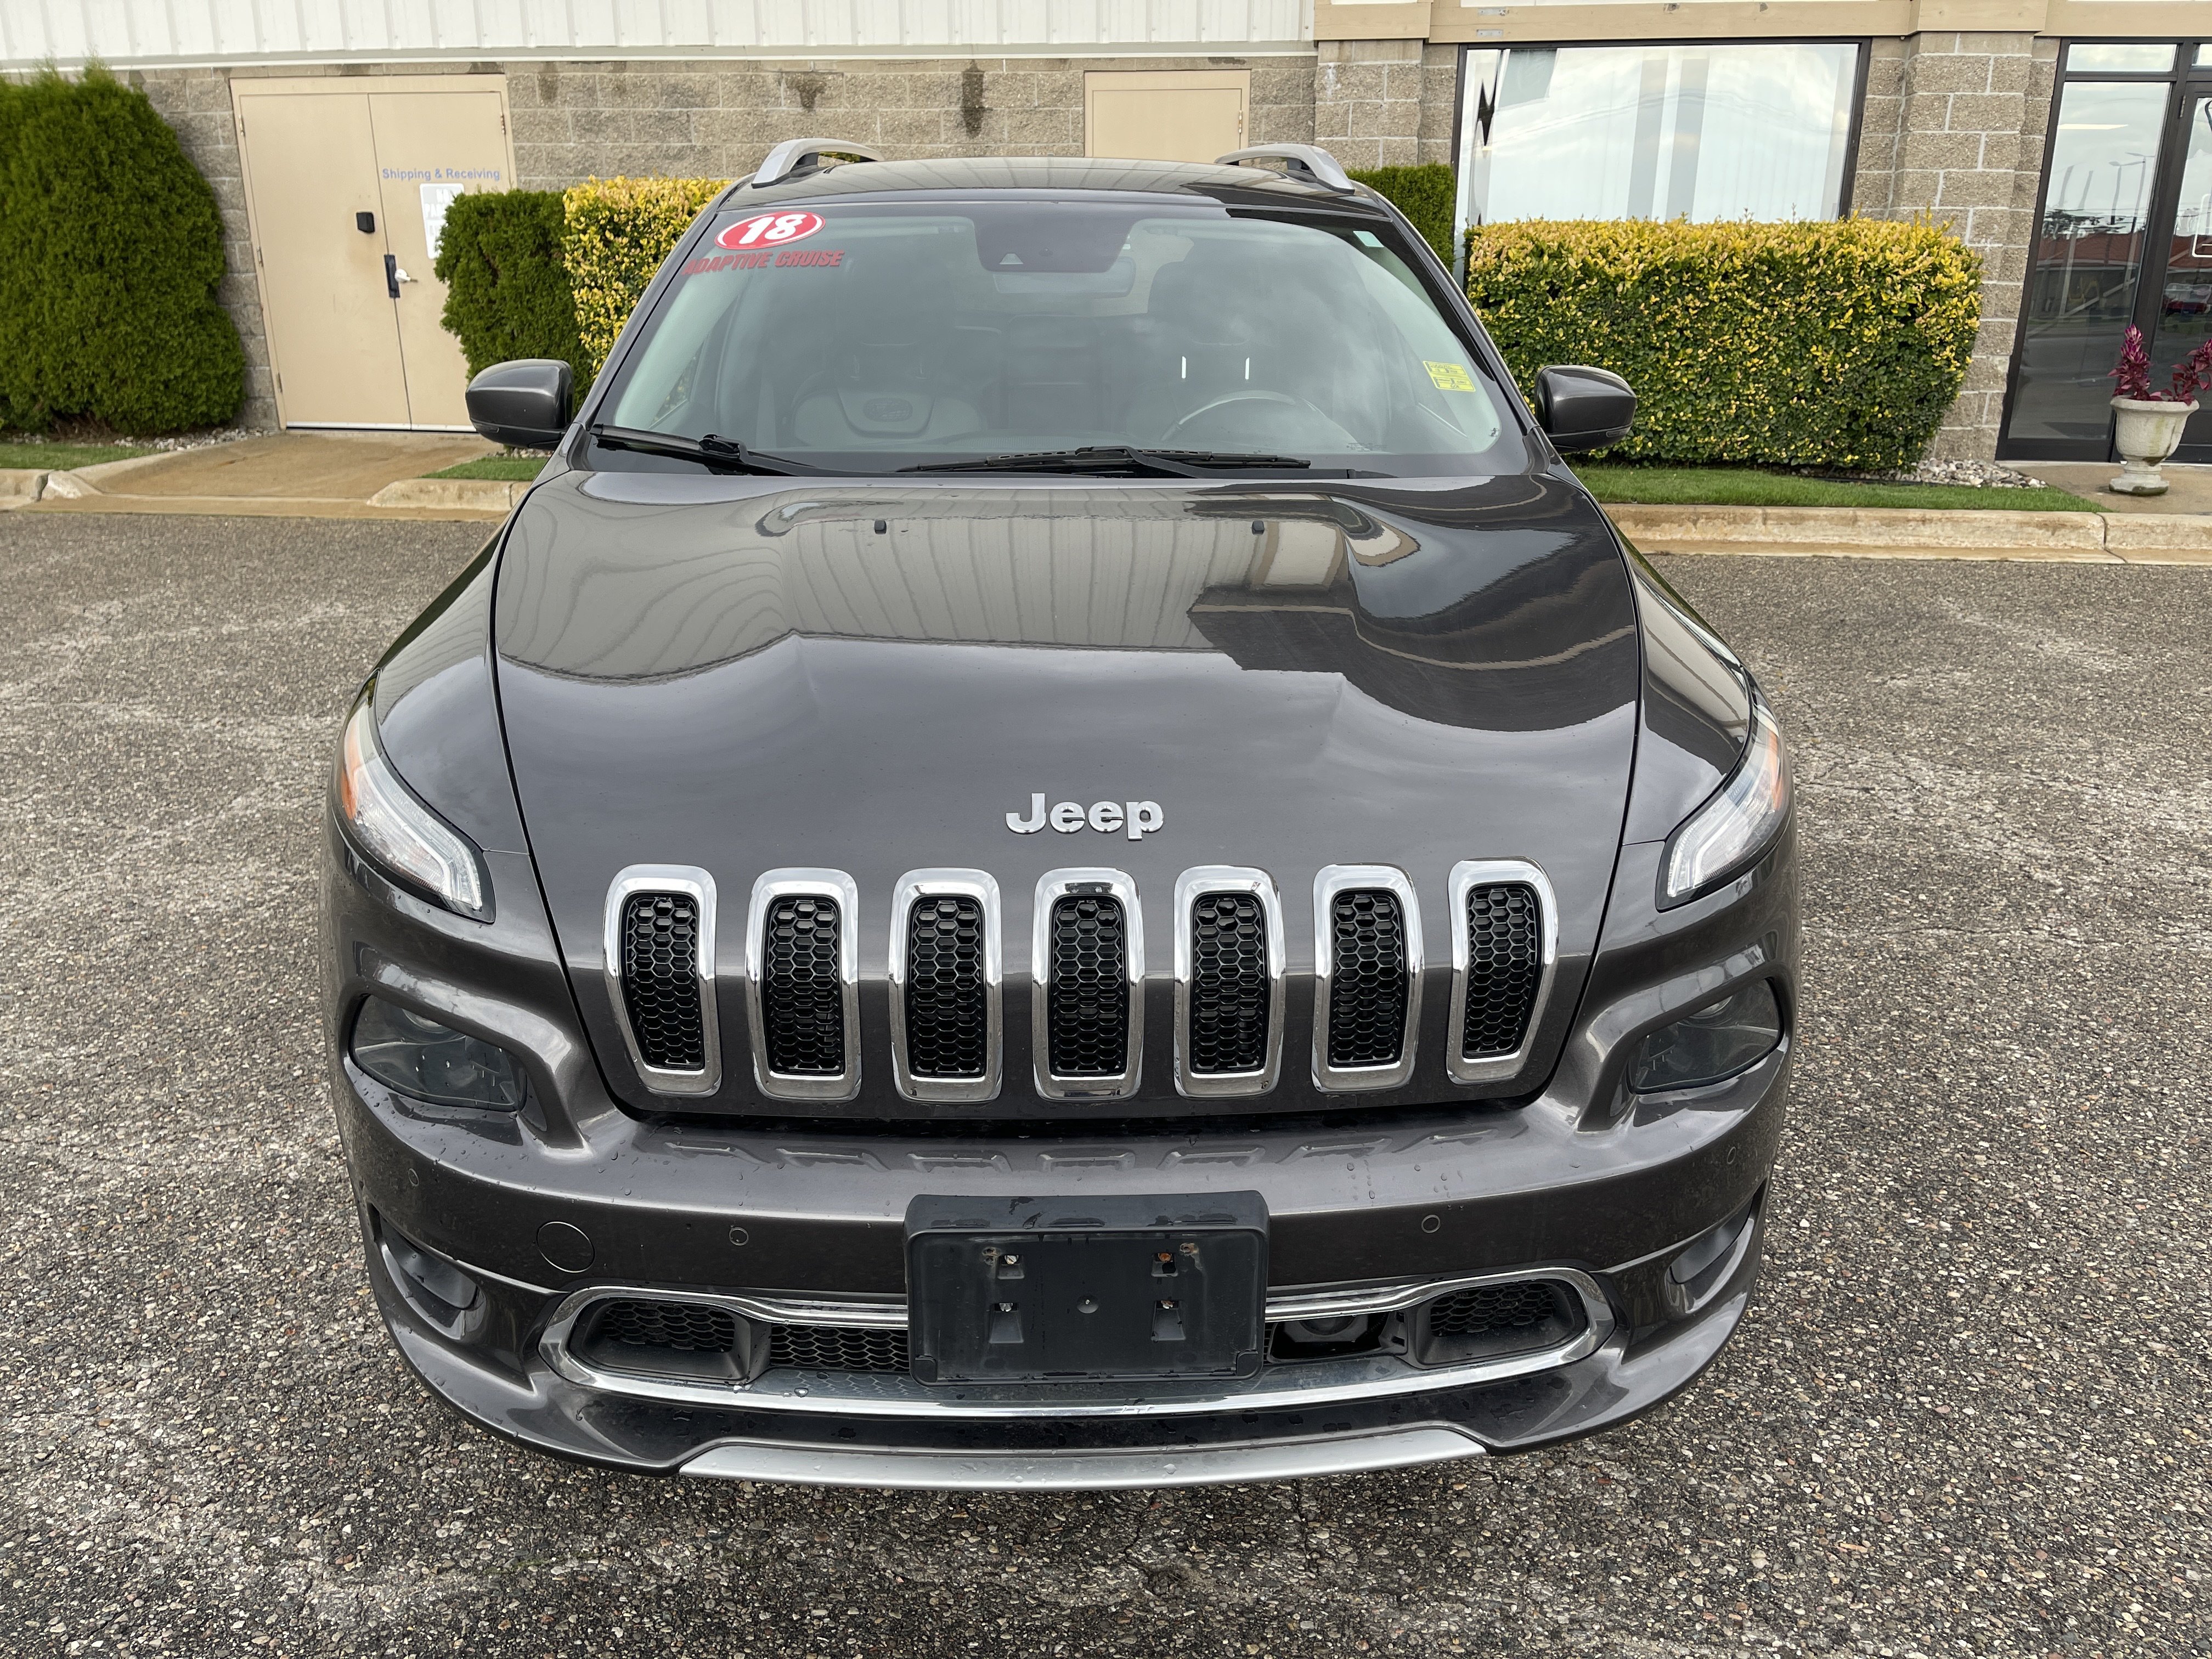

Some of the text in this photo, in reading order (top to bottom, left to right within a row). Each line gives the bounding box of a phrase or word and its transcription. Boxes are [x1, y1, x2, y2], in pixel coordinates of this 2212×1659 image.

[382, 168, 500, 180] Shipping & Receiving
[738, 214, 807, 244] 18
[681, 250, 845, 275] ADAPTIVE CRUISE
[1006, 793, 1164, 840] Jeep
